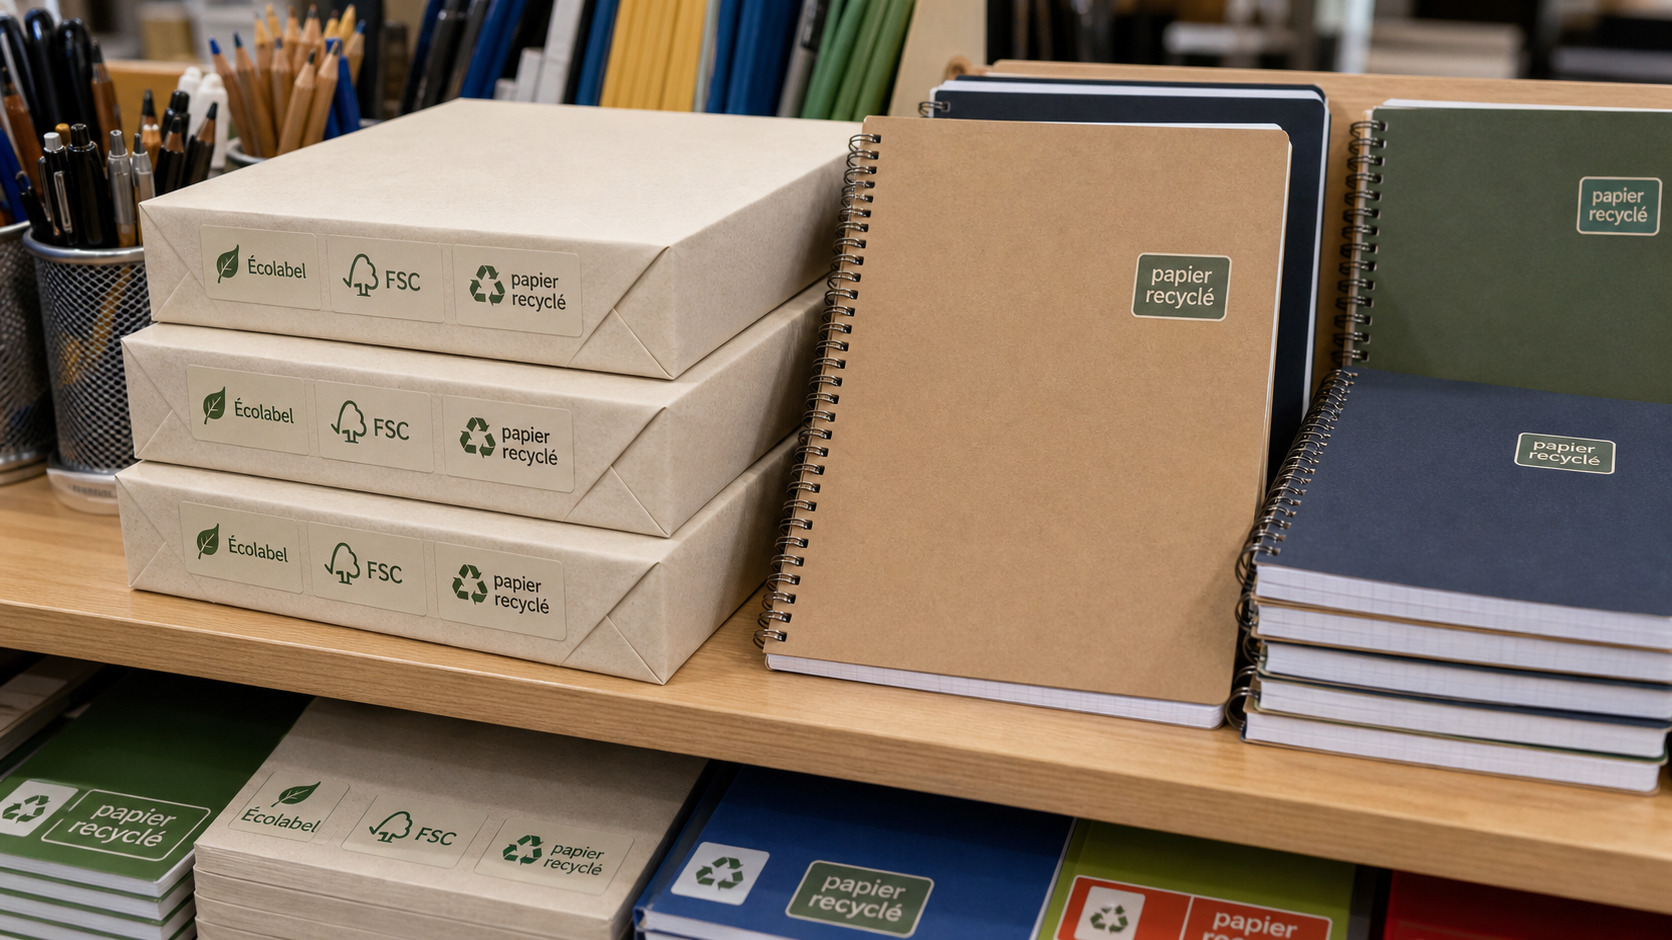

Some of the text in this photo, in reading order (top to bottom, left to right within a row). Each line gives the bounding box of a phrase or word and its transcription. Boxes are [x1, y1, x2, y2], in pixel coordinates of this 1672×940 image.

[1592, 187, 1645, 207] papier
[1588, 205, 1648, 226] recyclé
[247, 254, 307, 280] Écolabel
[1151, 265, 1213, 287] papier
[385, 270, 421, 292] FSC
[511, 270, 559, 291] papier
[512, 291, 567, 312] recyclé
[1145, 287, 1215, 309] recyclé
[234, 396, 295, 425] Écolabel
[373, 417, 410, 441] FSC
[501, 425, 551, 445] papier
[502, 445, 558, 467] recyclé
[1533, 441, 1596, 453] papier
[1529, 452, 1601, 466] recyclé
[228, 535, 289, 564] Écolabel
[366, 560, 403, 584] FSC
[493, 573, 542, 593] papier
[494, 593, 550, 615] recyclé
[90, 803, 177, 828] papier
[240, 806, 322, 834] Écolabel
[67, 820, 166, 848] recyclé
[414, 826, 458, 846] FSC
[549, 844, 606, 861] papier
[542, 857, 603, 876] recyclé
[820, 875, 907, 900] papier
[807, 894, 903, 922] recyclé
[1212, 912, 1298, 938] papier
